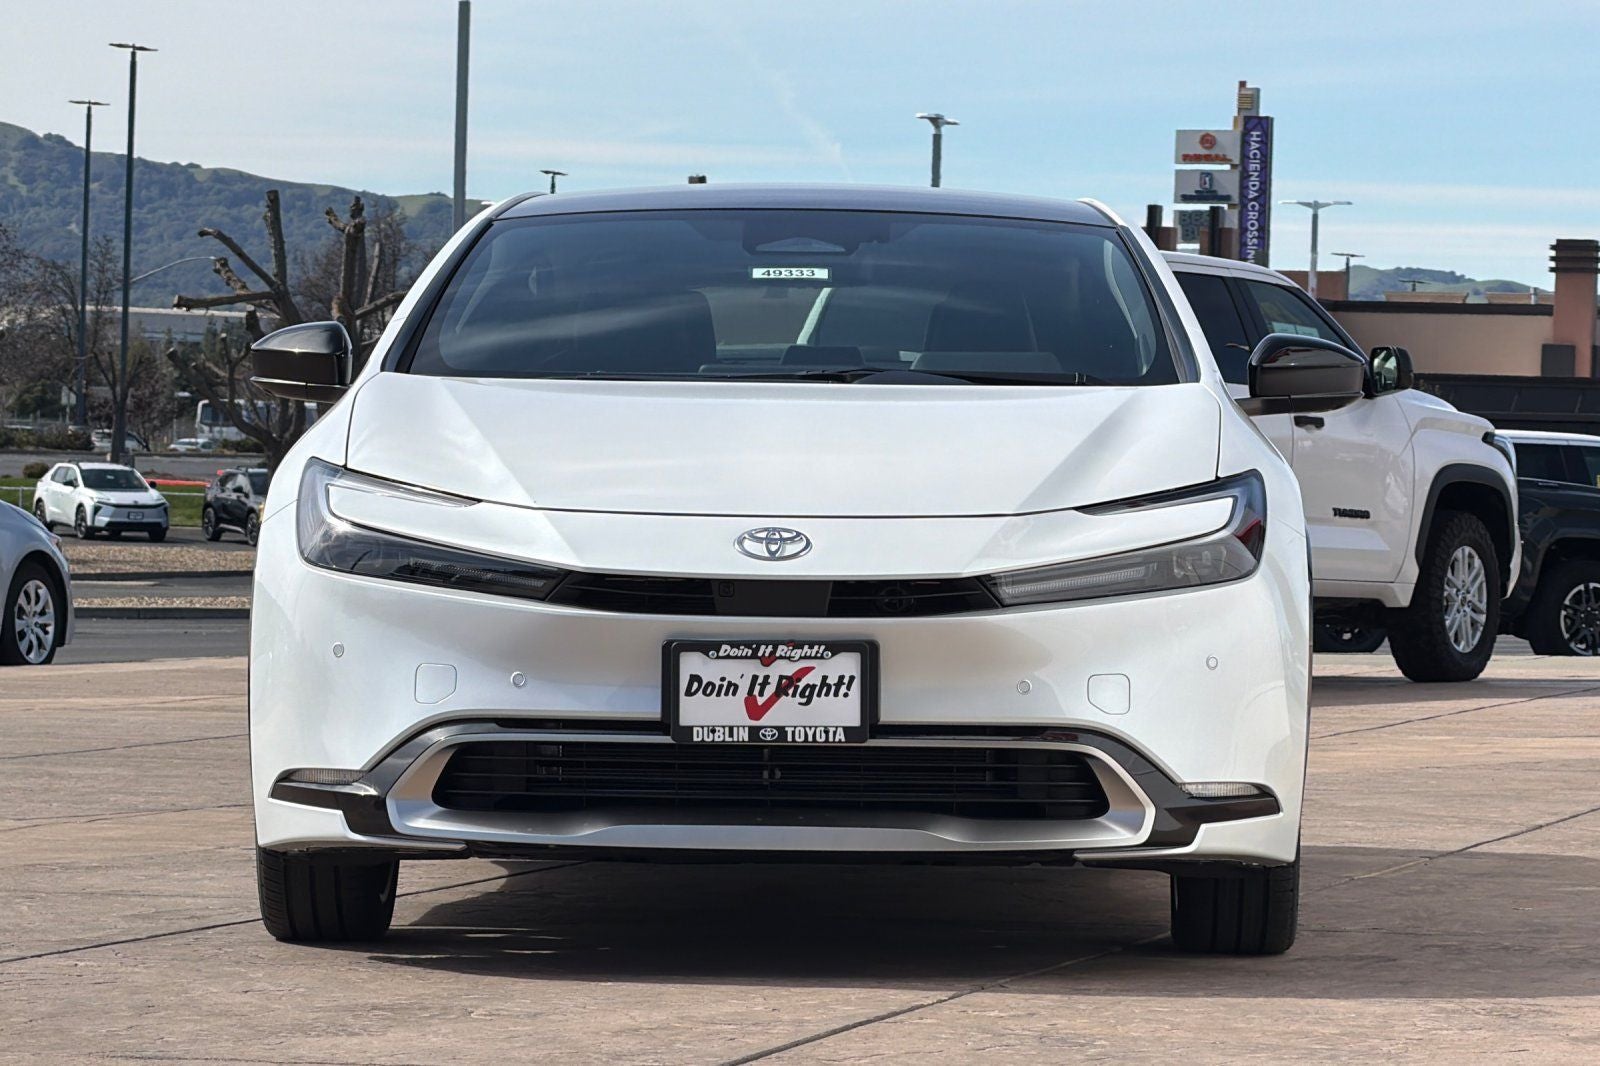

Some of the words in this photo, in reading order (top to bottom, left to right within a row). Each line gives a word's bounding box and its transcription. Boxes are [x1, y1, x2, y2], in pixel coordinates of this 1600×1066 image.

[1248, 131, 1261, 199] HACIENDA
[761, 269, 816, 277] 49333
[718, 644, 757, 657] Doin'
[757, 644, 774, 657] It
[775, 644, 826, 661] Right!
[684, 674, 745, 698] Doin'
[746, 674, 771, 698] It
[774, 674, 856, 706] Right!
[692, 726, 749, 742] DUBLIN
[784, 726, 846, 742] TOYOTA
